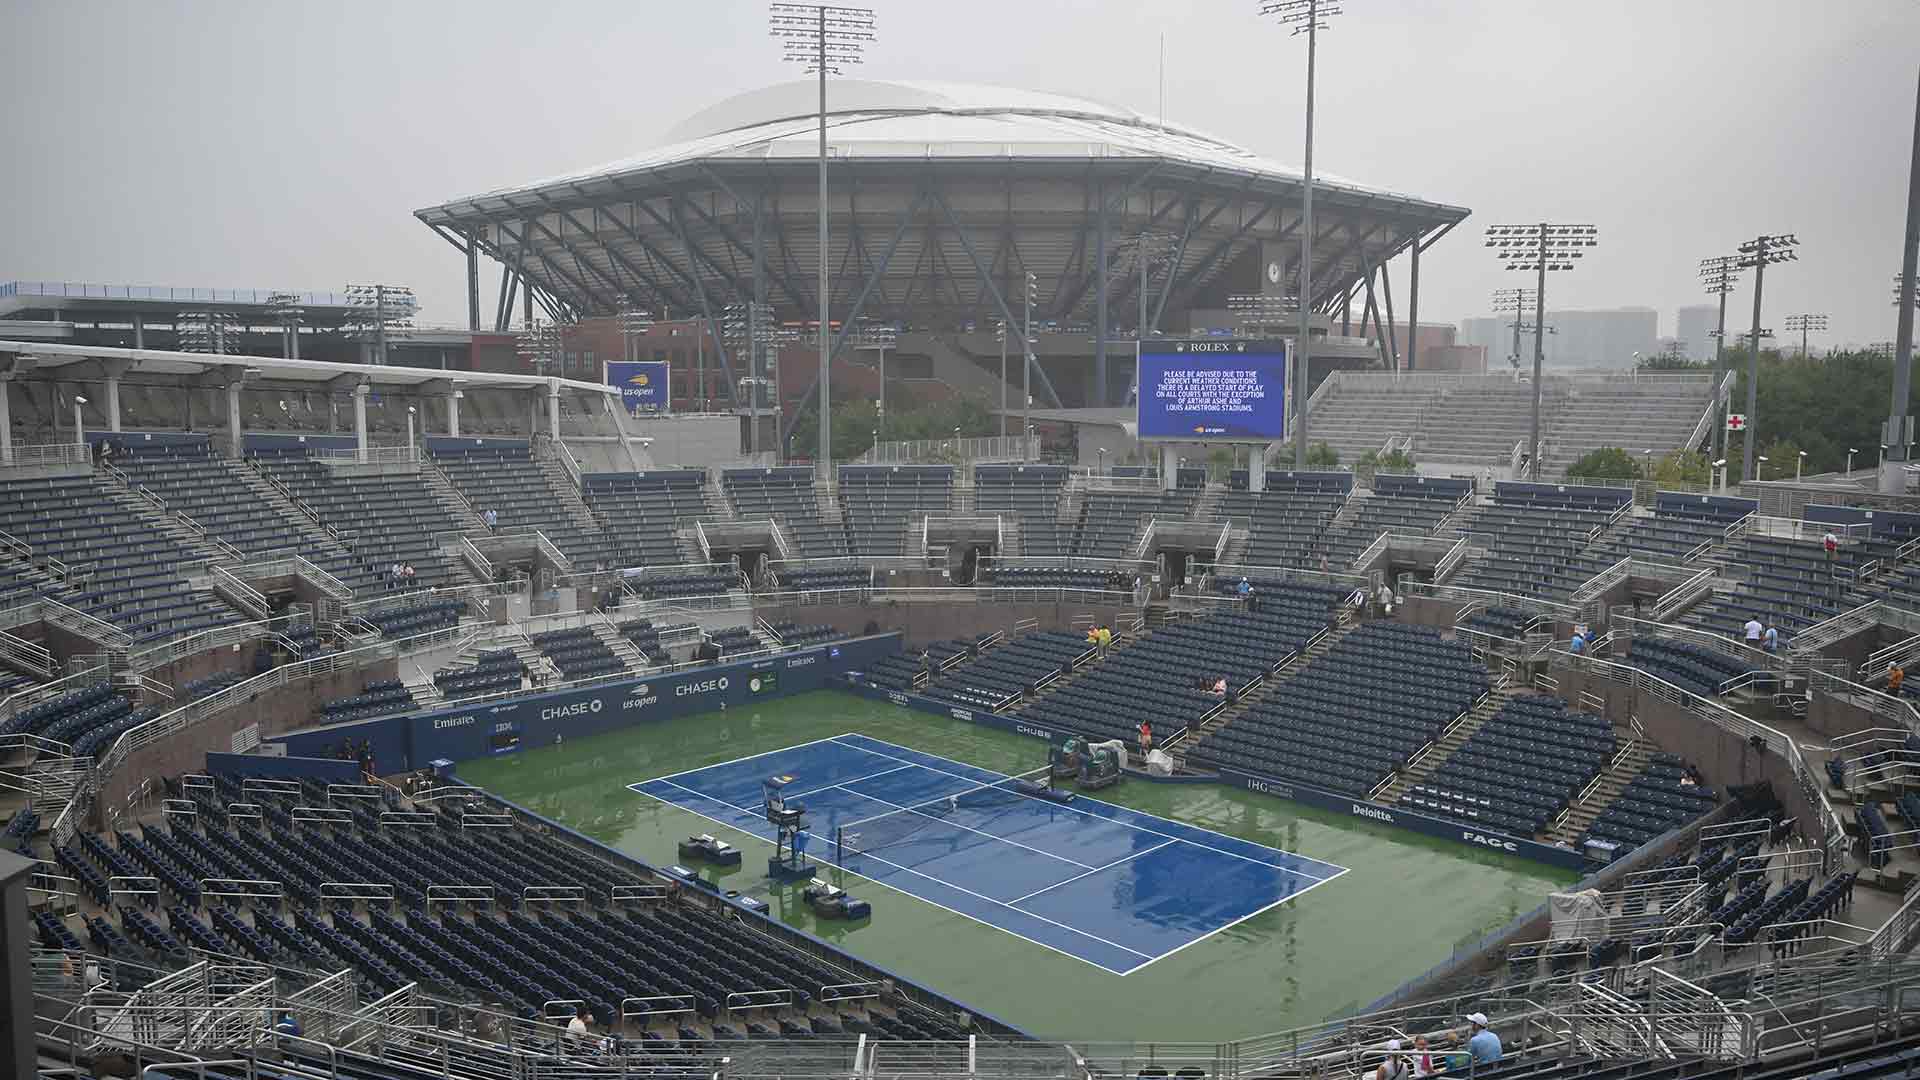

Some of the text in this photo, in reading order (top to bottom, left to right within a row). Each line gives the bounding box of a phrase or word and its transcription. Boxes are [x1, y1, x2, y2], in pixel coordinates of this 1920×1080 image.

[1191, 343, 1230, 352] ROLEX
[676, 681, 716, 696] CHASE
[542, 702, 588, 720] CHASE
[434, 714, 475, 728] Emirates
[1248, 778, 1268, 792] IHG
